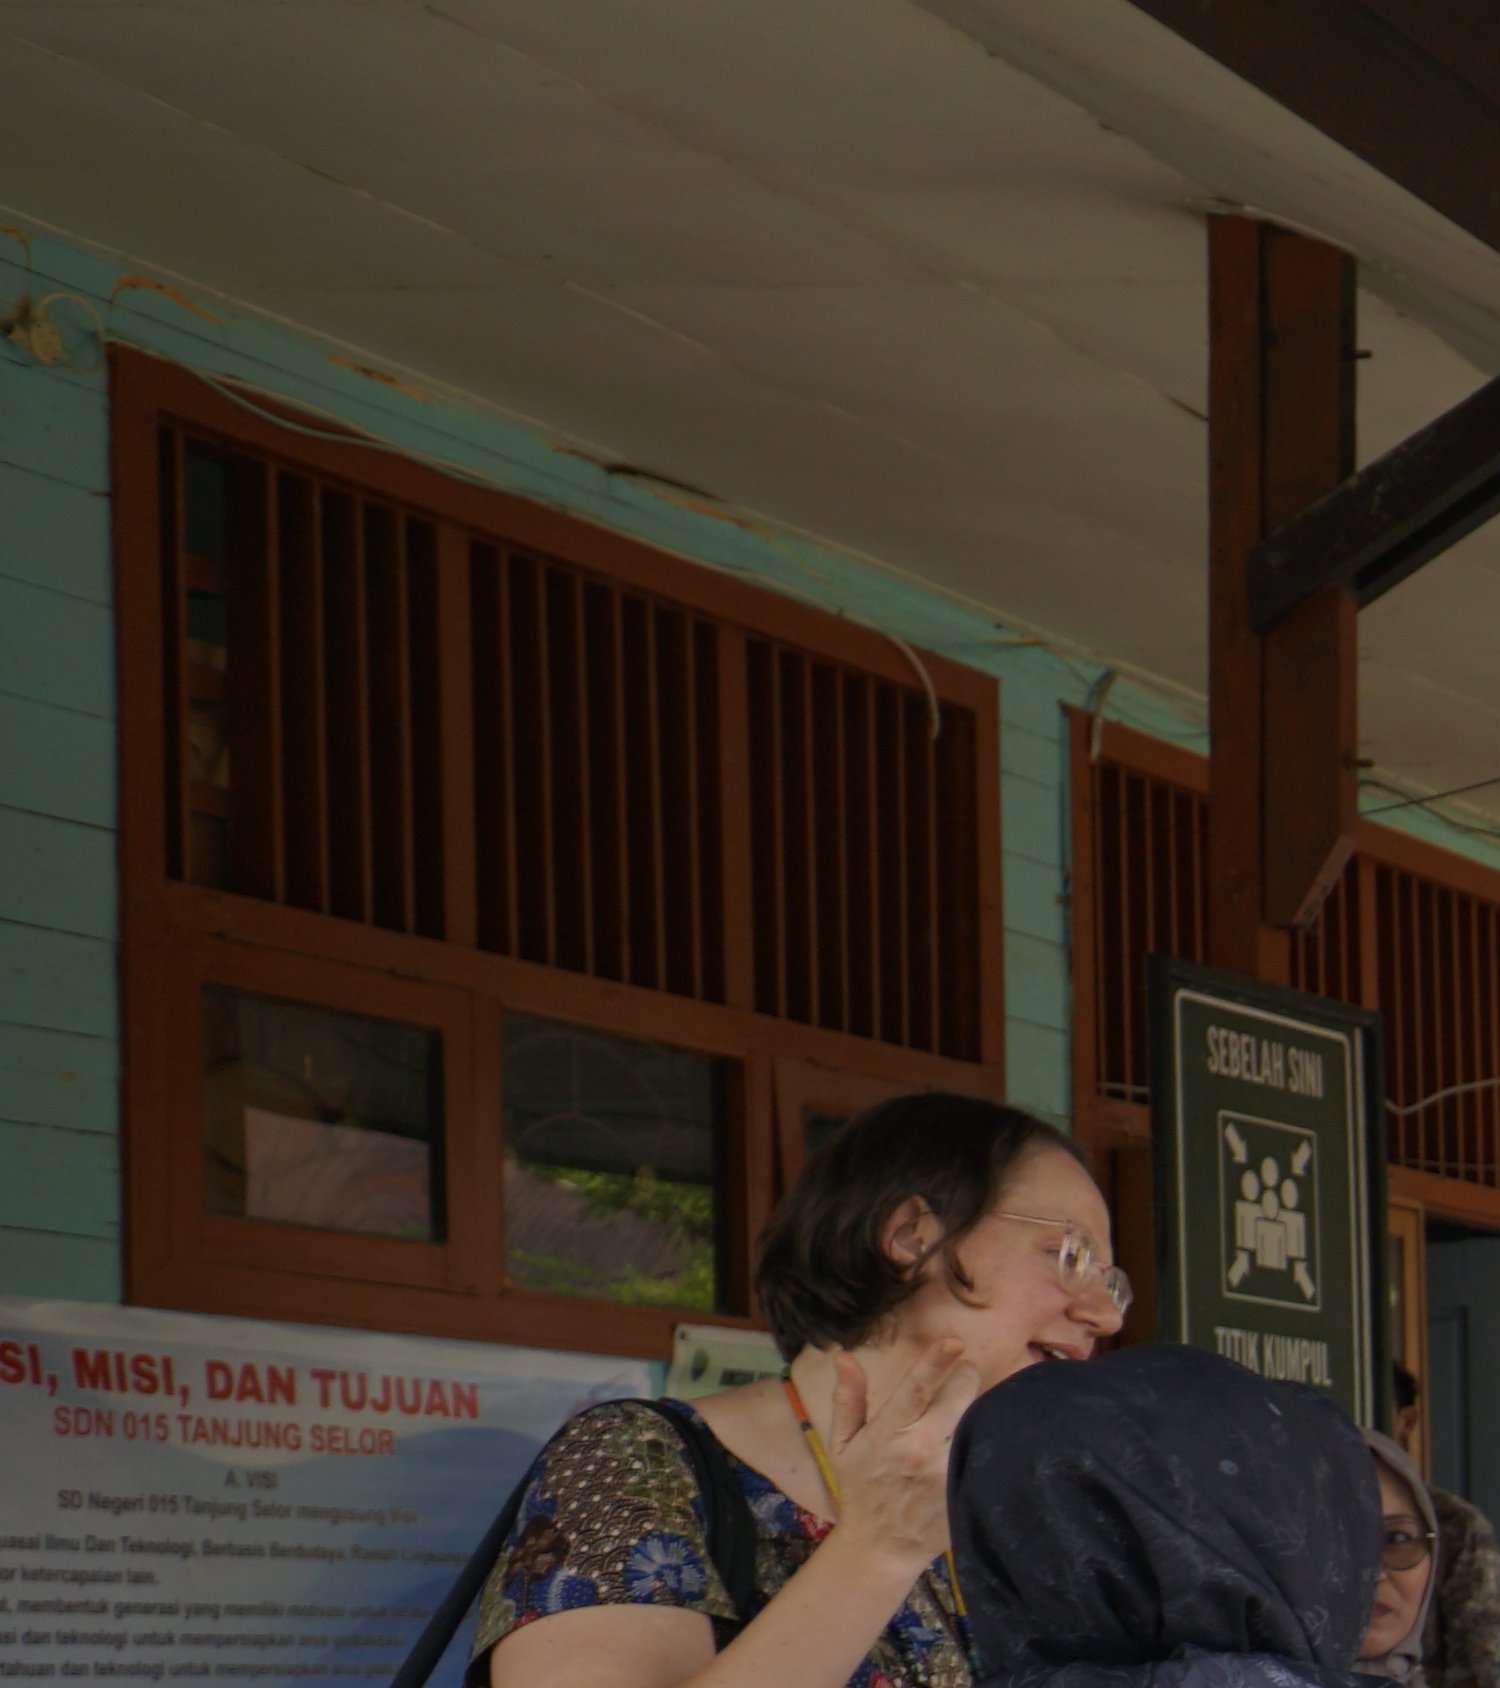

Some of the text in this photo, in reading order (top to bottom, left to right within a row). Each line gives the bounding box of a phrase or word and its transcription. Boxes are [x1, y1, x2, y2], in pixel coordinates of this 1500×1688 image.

[1207, 1024, 1324, 1098] SEBELAH SINI
[1262, 1333, 1333, 1387] KUMPUL
[72, 1347, 189, 1406] MISI,
[206, 1357, 297, 1407] DAN
[311, 1370, 479, 1421] TUJUAN
[54, 1405, 396, 1457] SDN 015 TANJUNG SELOR
[246, 1469, 278, 1489] VISI
[57, 1488, 83, 1511] SD
[87, 1490, 145, 1516] Negeri
[148, 1493, 180, 1514] 015
[183, 1495, 247, 1521] Tanjung
[251, 1498, 292, 1520] Selor
[84, 1534, 116, 1552] Dan
[184, 1602, 220, 1621] yang
[21, 1627, 51, 1645] dan
[55, 1629, 128, 1652] teknologi
[131, 1629, 176, 1646] untuk
[60, 1660, 90, 1677] dan
[93, 1659, 165, 1681] teknologi
[168, 1659, 211, 1677] untuk
